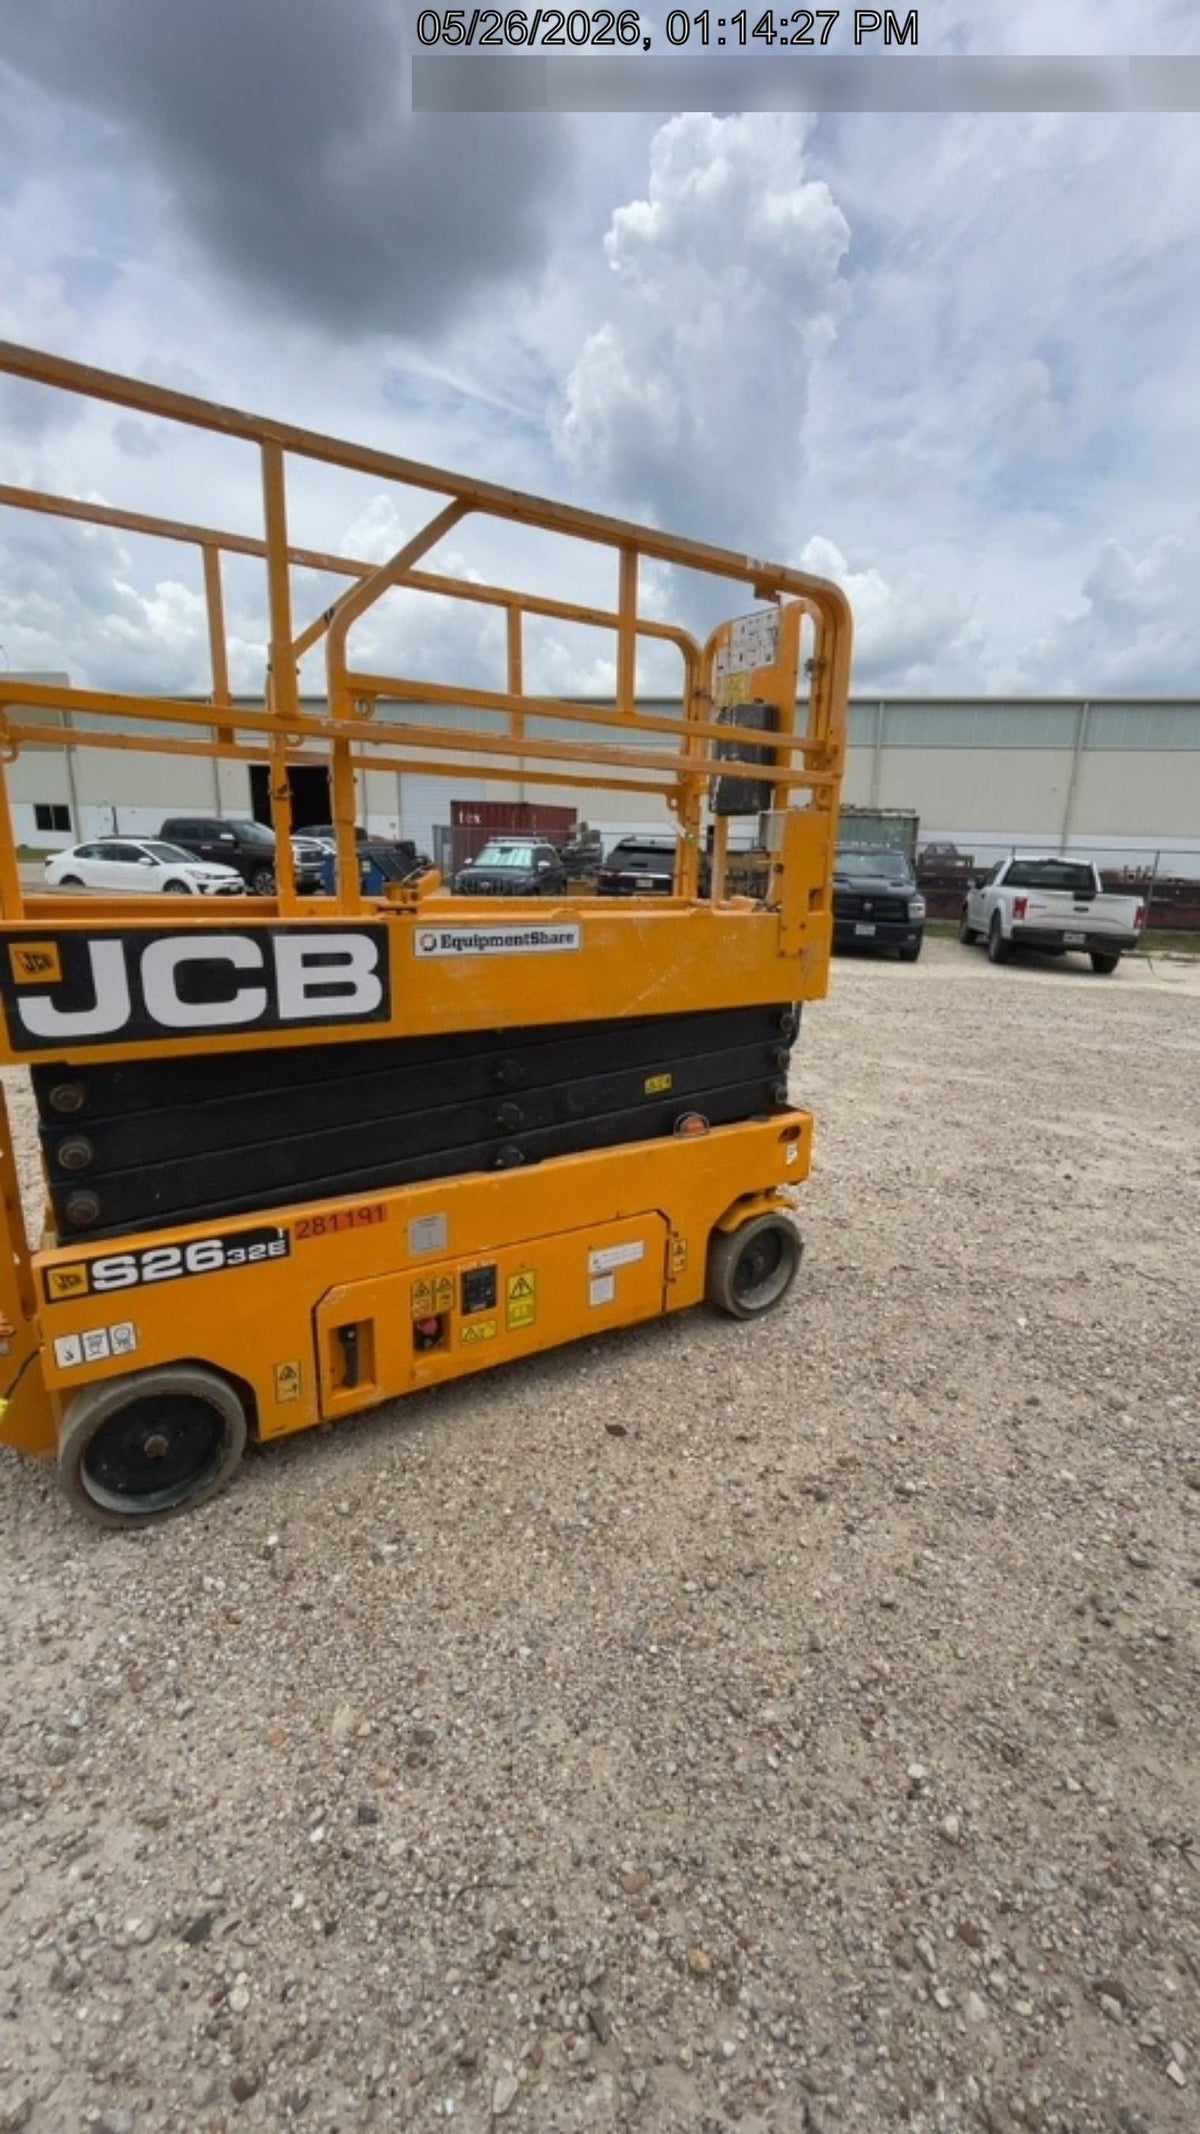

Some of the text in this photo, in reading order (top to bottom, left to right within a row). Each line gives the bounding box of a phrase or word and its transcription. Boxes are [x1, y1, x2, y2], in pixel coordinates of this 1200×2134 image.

[440, 931, 575, 951] EquipmentShare
[17, 933, 382, 1037] JCB
[297, 1203, 385, 1238] 281191
